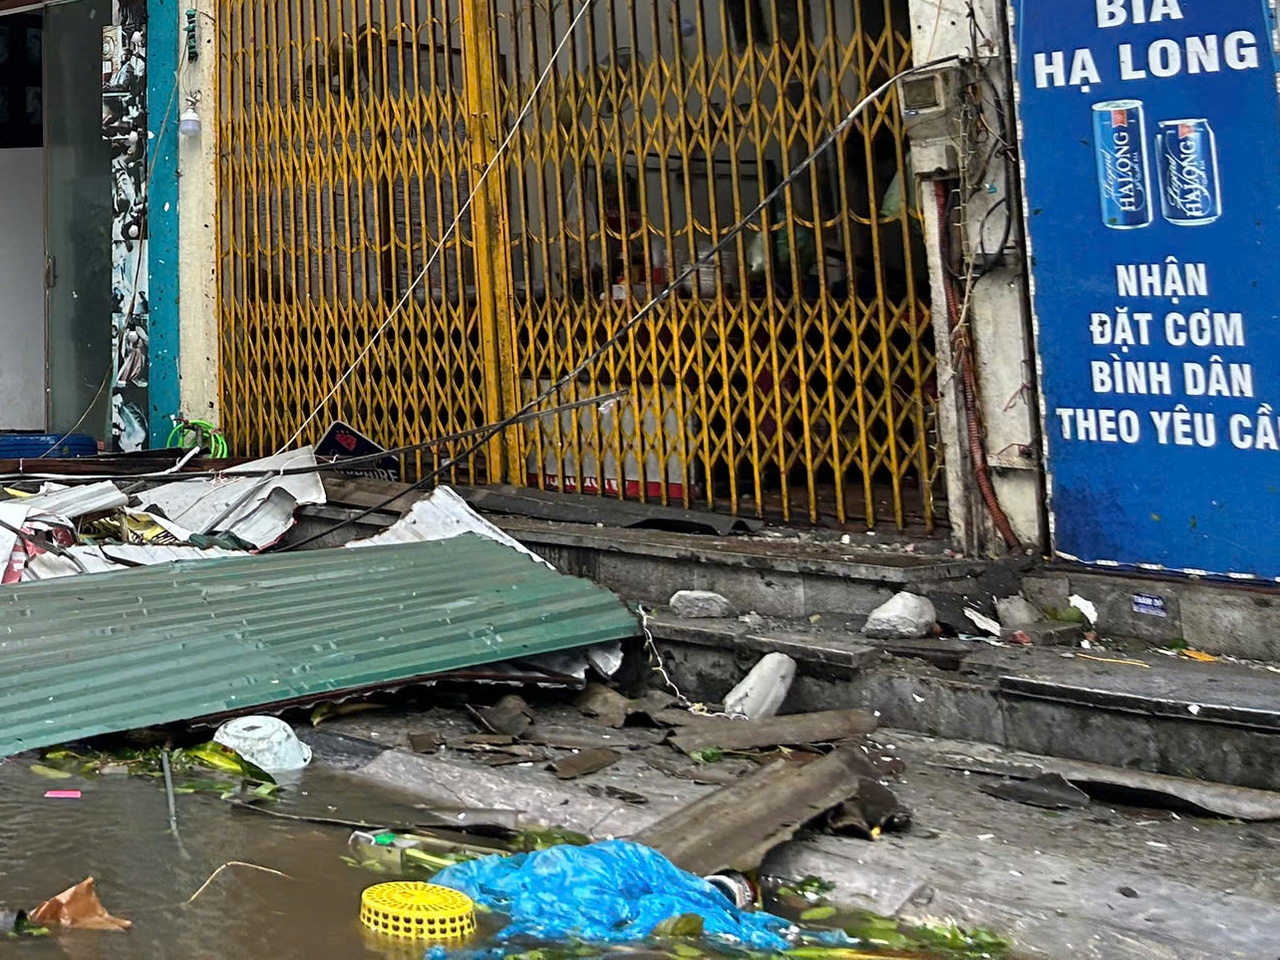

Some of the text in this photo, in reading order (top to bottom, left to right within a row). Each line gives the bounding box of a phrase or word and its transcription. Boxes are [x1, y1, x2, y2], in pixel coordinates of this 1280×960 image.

[1034, 30, 1259, 93] HẠ LONG
[1113, 131, 1136, 211] HALONG
[1116, 255, 1208, 305] NHẬN
[1089, 305, 1245, 353] ĐẶT CƠM
[1091, 353, 1254, 398] BÌNH DÂN
[1055, 403, 1280, 451] THEO YÊU CẦ
